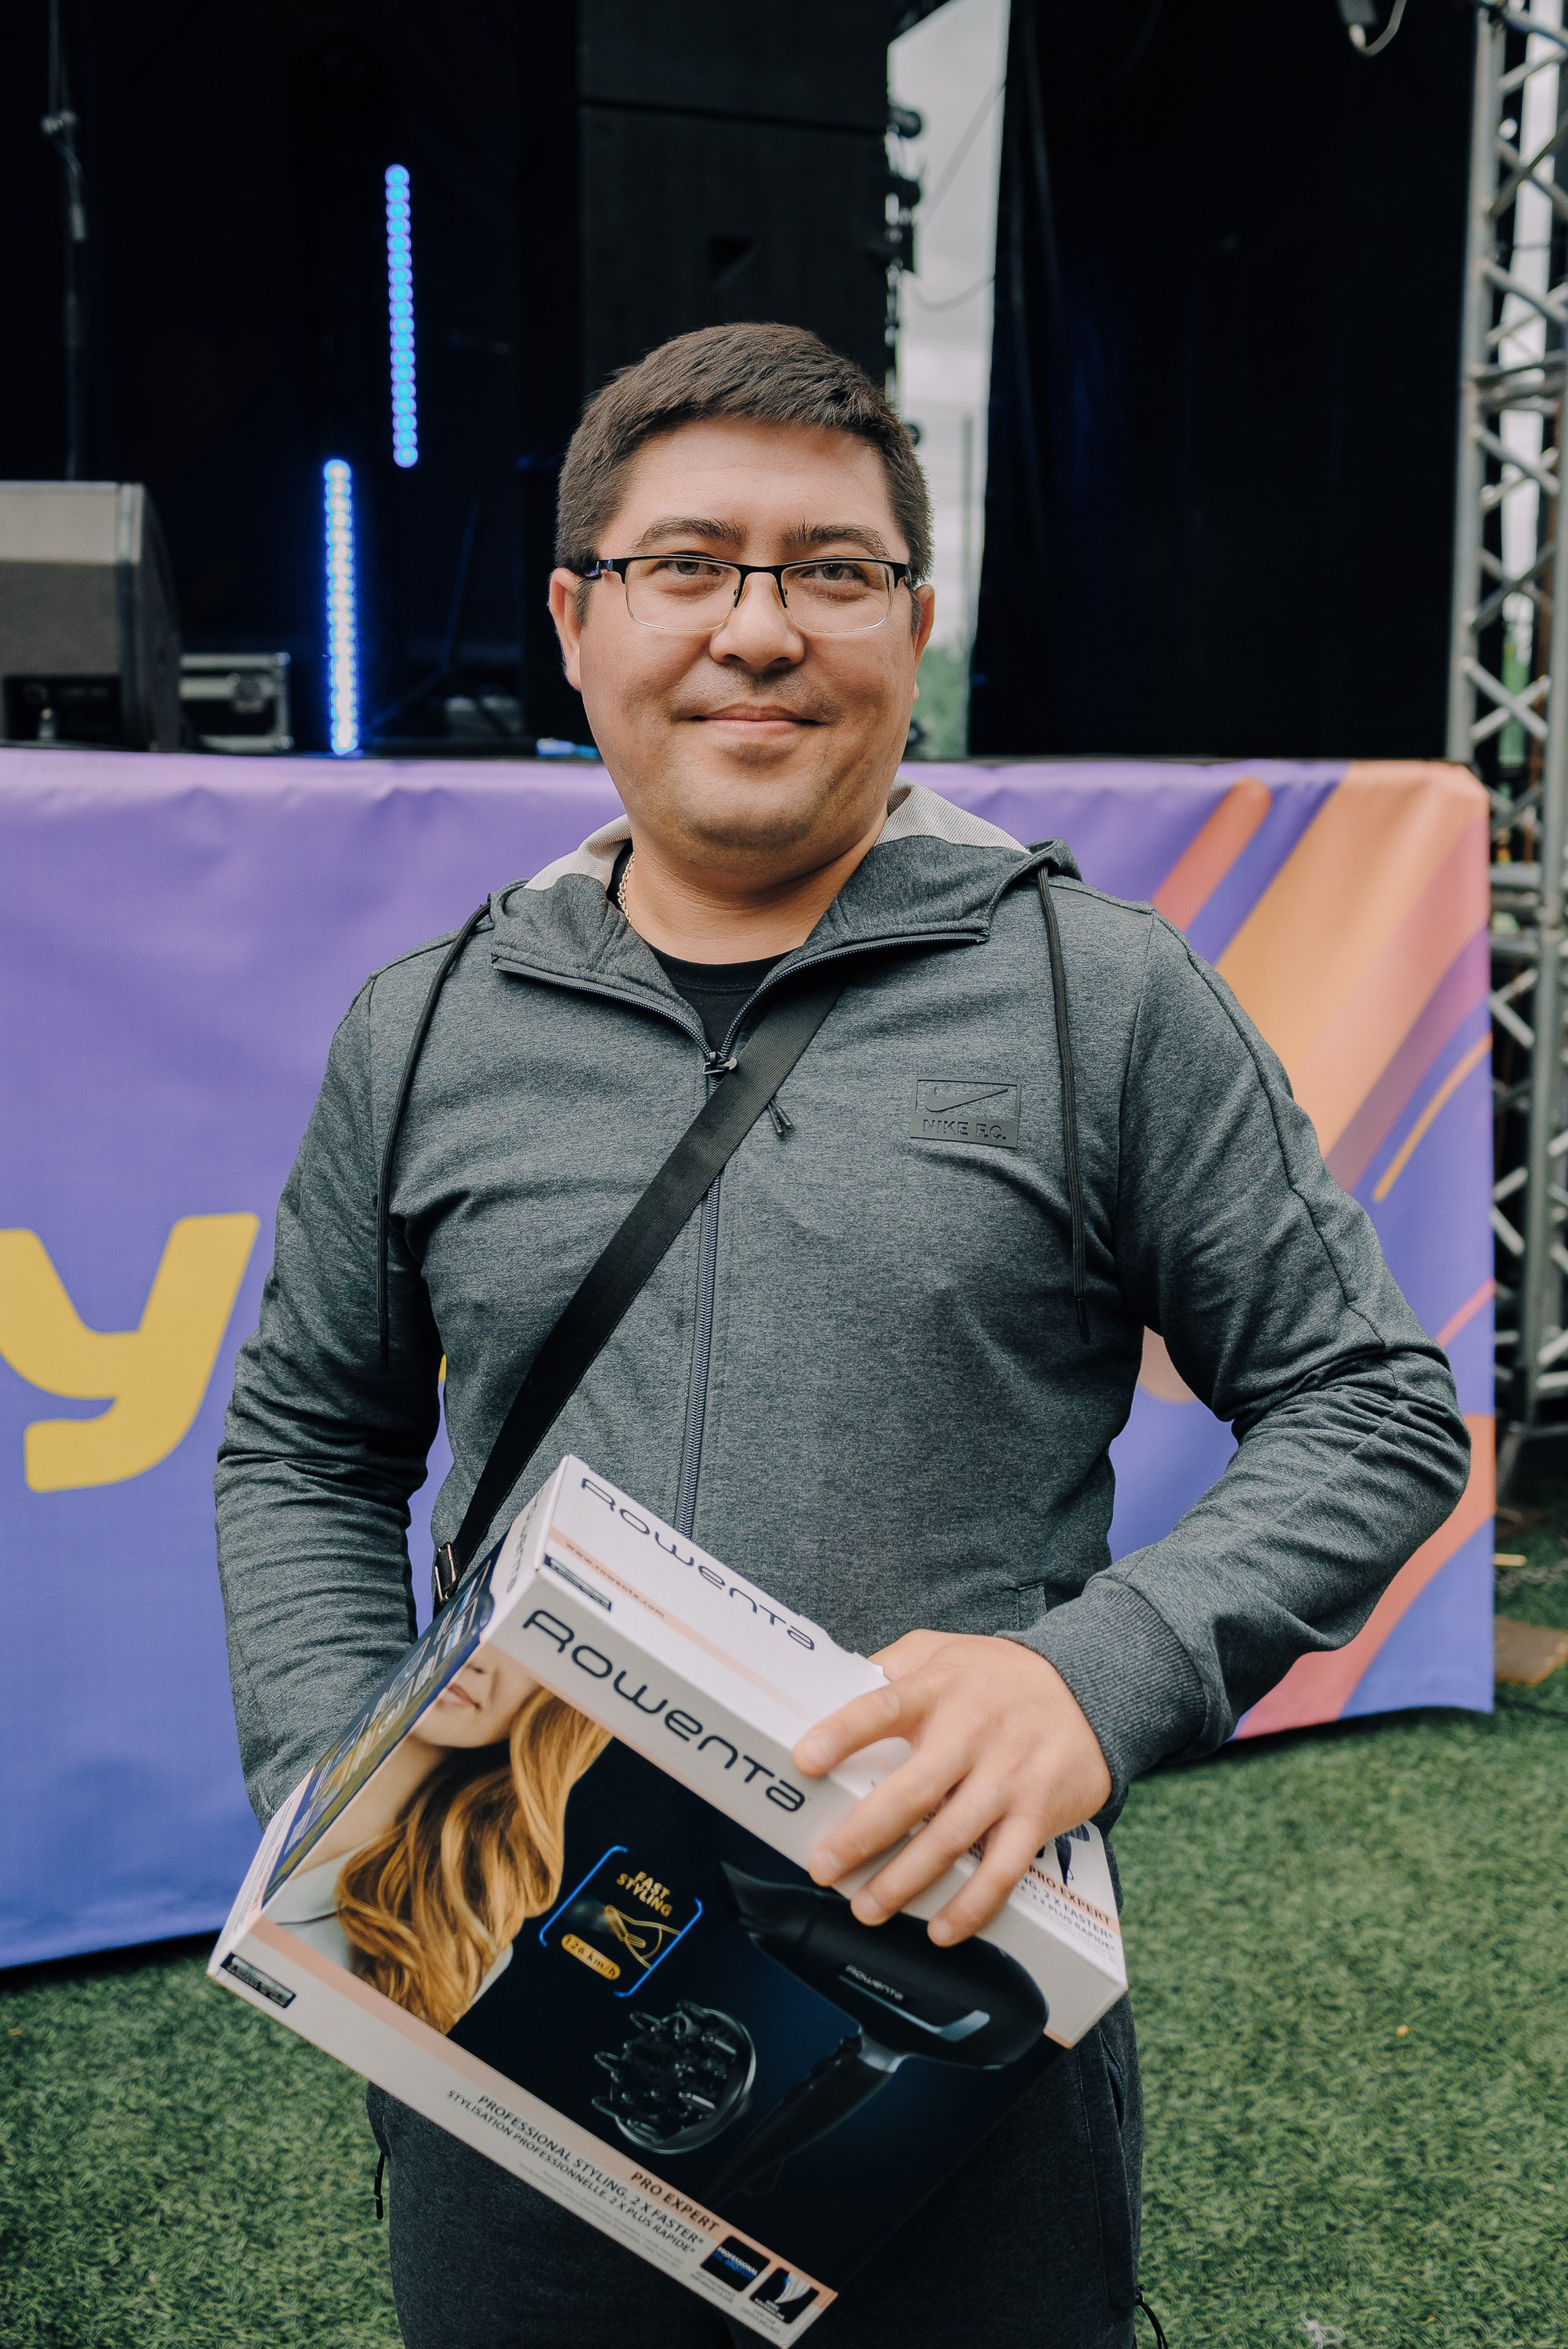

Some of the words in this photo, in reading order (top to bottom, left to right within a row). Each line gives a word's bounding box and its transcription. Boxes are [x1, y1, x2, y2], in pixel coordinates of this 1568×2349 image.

[923, 1119, 968, 1136] NIKE
[976, 1123, 1007, 1141] F.C.
[566, 1542, 665, 1618] www.rowenta.com
[616, 1873, 672, 1917] STYLING
[634, 1871, 671, 1899] FAST
[1060, 1885, 1110, 1925] EXPERT
[447, 2089, 514, 2137] STYLISATION
[626, 2206, 652, 2228] PLUS
[478, 2094, 571, 2162] PROFESSIONAL
[630, 2195, 640, 2205] 2
[640, 2201, 652, 2213] X
[631, 2171, 663, 2196] PRO
[663, 2192, 720, 2232] EXPERT
